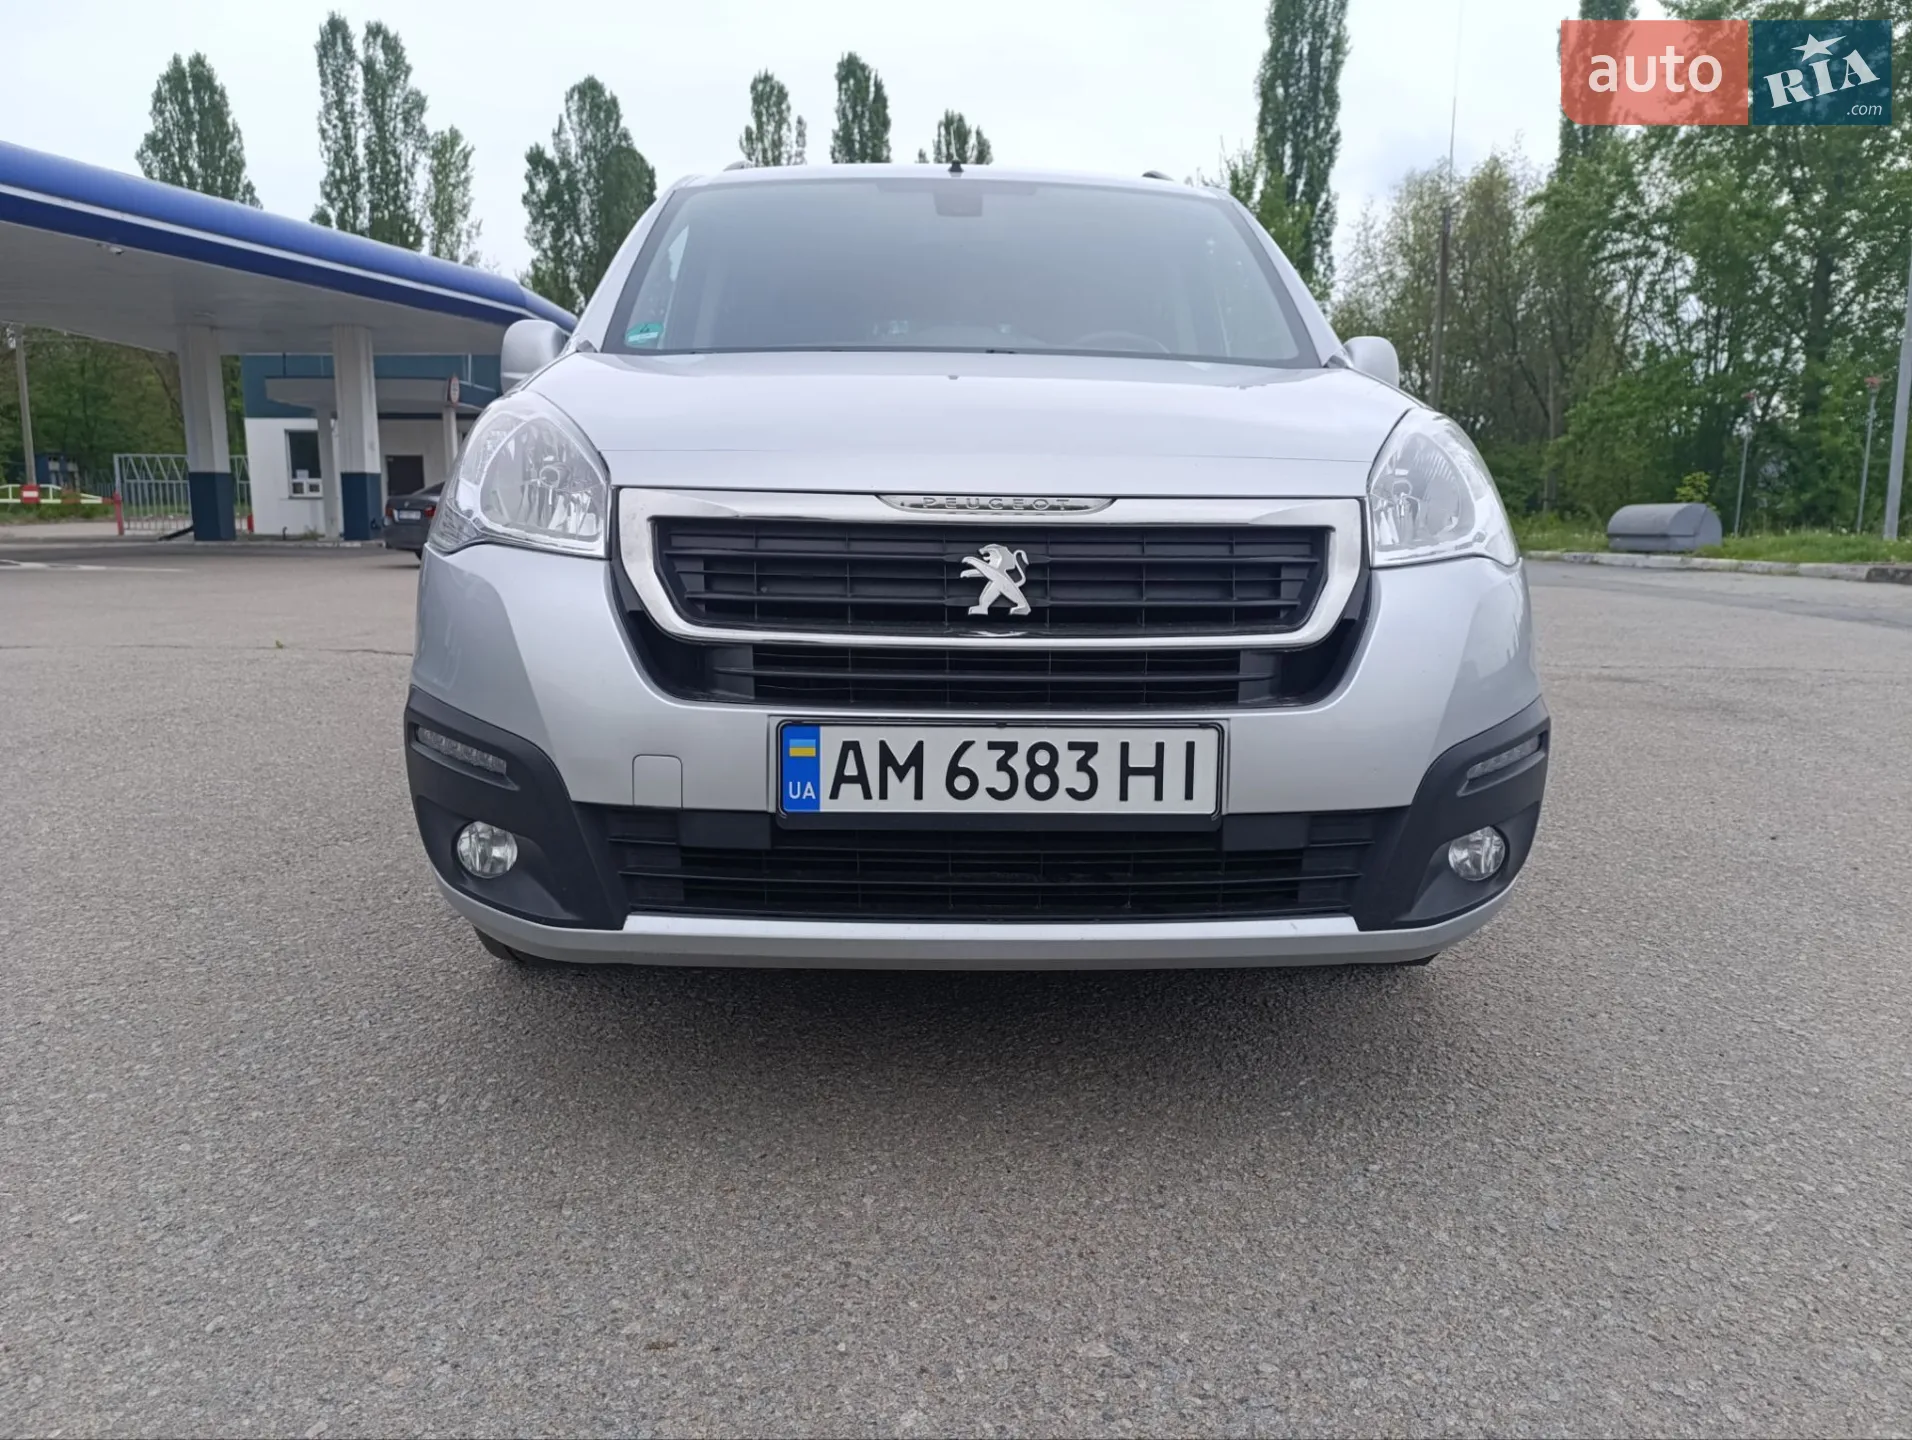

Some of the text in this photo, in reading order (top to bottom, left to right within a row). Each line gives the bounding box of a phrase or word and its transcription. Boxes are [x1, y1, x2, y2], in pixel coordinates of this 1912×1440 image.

[922, 496, 1070, 511] PEUGEOT
[828, 739, 1196, 802] AM 6383 HI
[788, 781, 816, 800] UA
